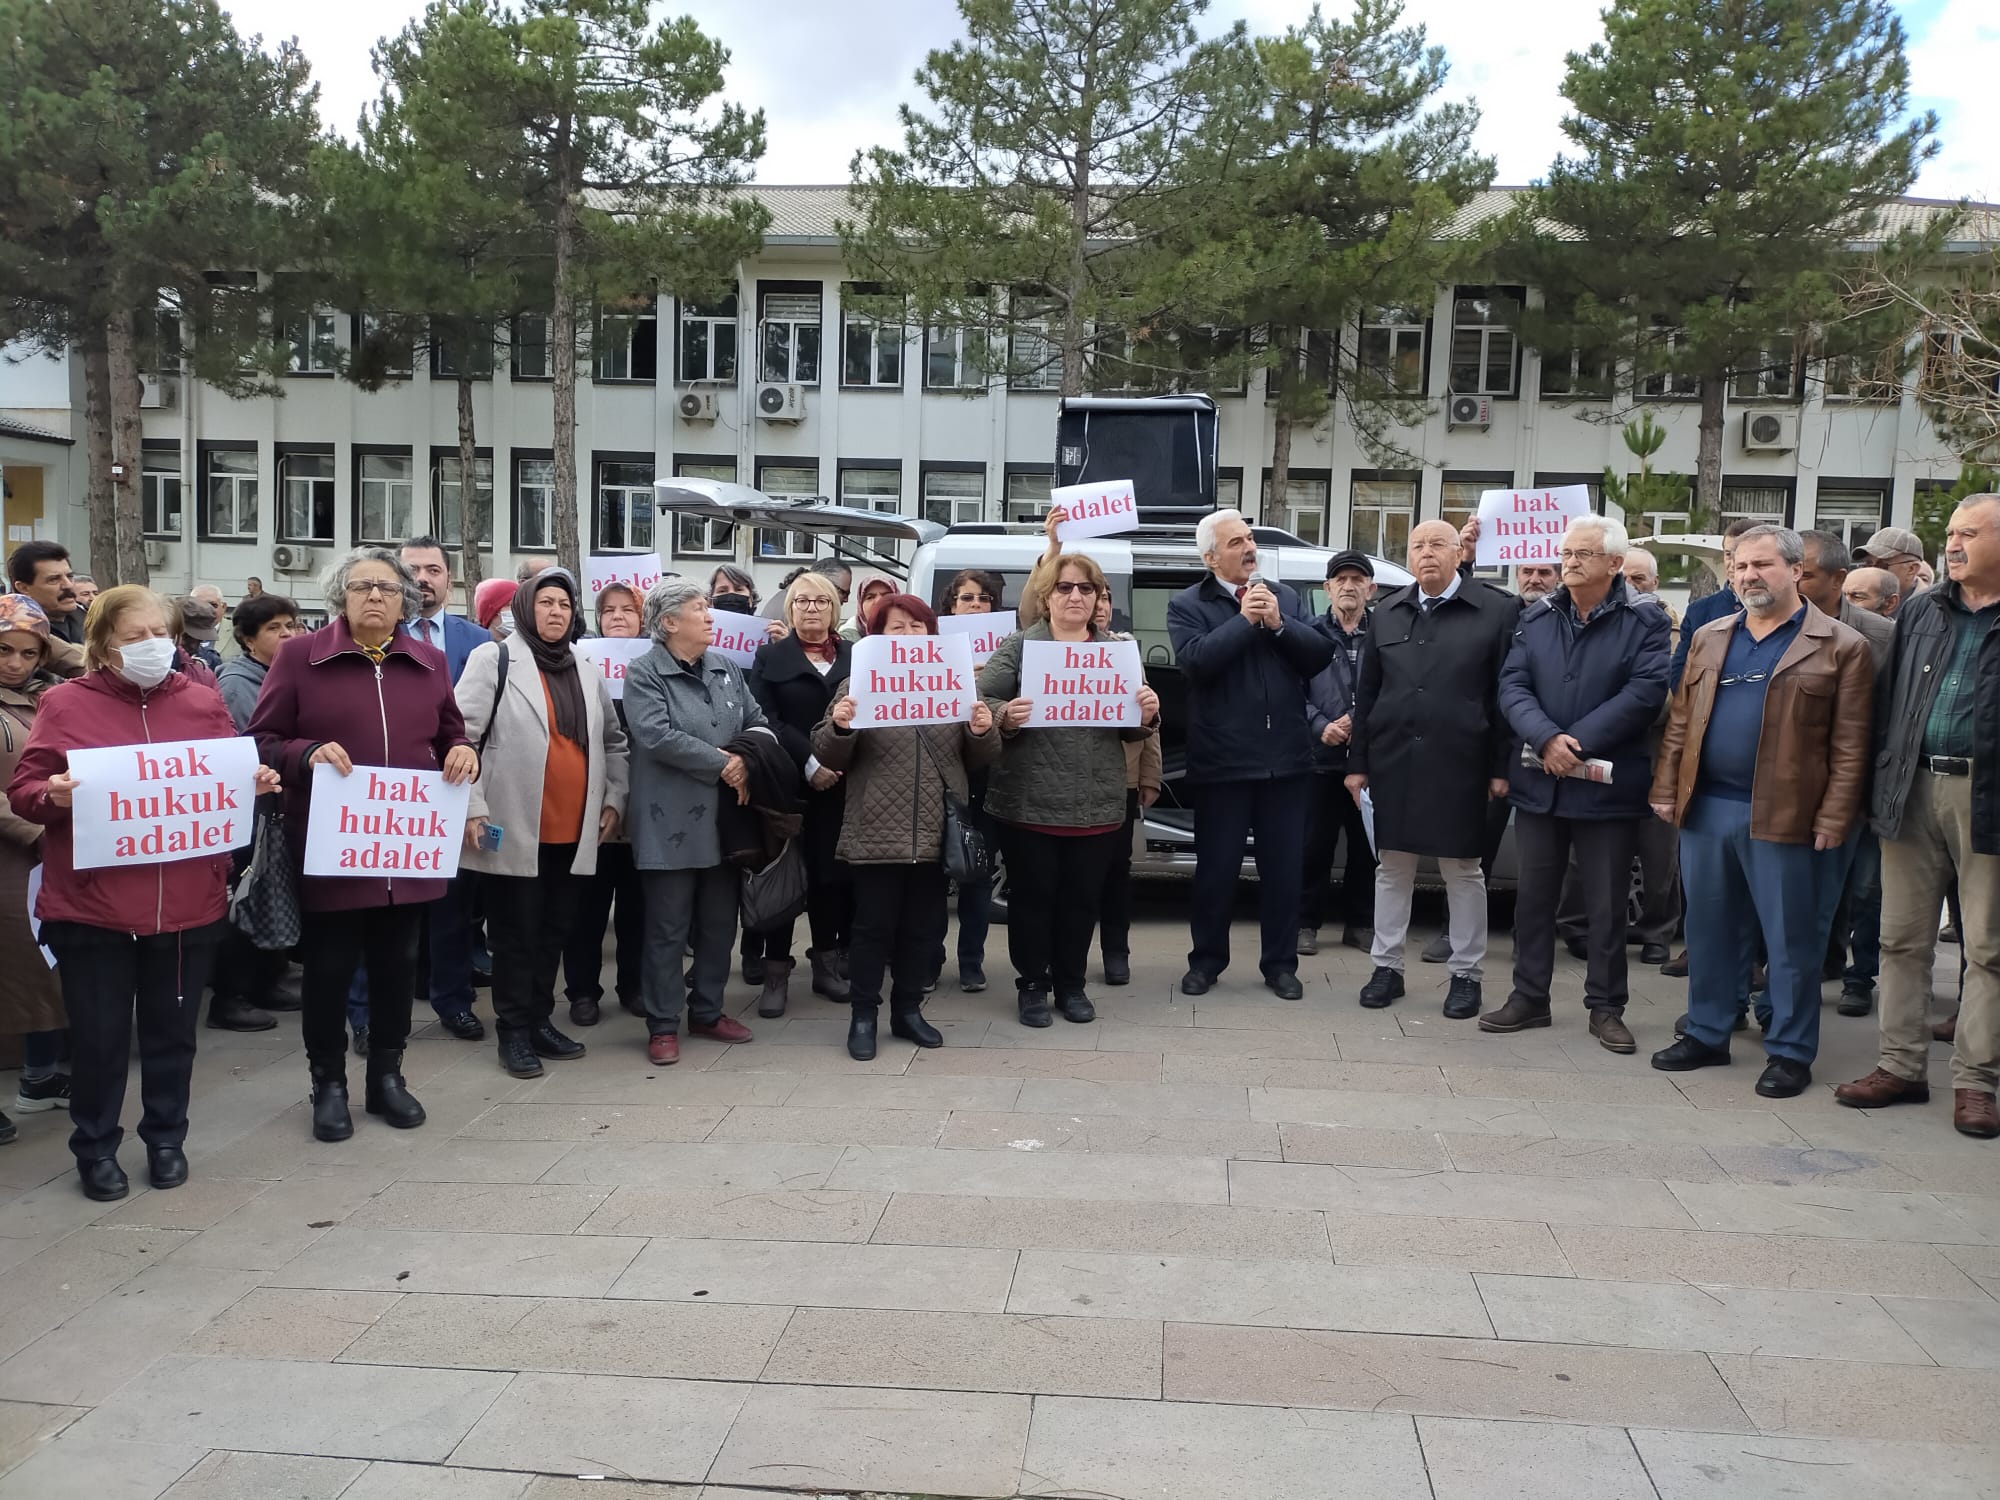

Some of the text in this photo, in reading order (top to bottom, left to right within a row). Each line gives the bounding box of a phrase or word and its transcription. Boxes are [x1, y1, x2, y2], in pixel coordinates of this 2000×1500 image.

[1513, 492, 1560, 513] hak
[890, 641, 944, 664] hak
[1065, 647, 1114, 669] hak
[870, 669, 963, 694] hukuk
[1043, 674, 1130, 695] hukuk
[873, 697, 961, 721] adalet
[1044, 700, 1126, 721] adalet
[135, 747, 212, 781] hak
[368, 773, 429, 803] hak
[109, 782, 239, 822] hukuk
[339, 806, 448, 838] hukuk
[114, 819, 235, 858] adalet
[339, 842, 443, 871] adalet
